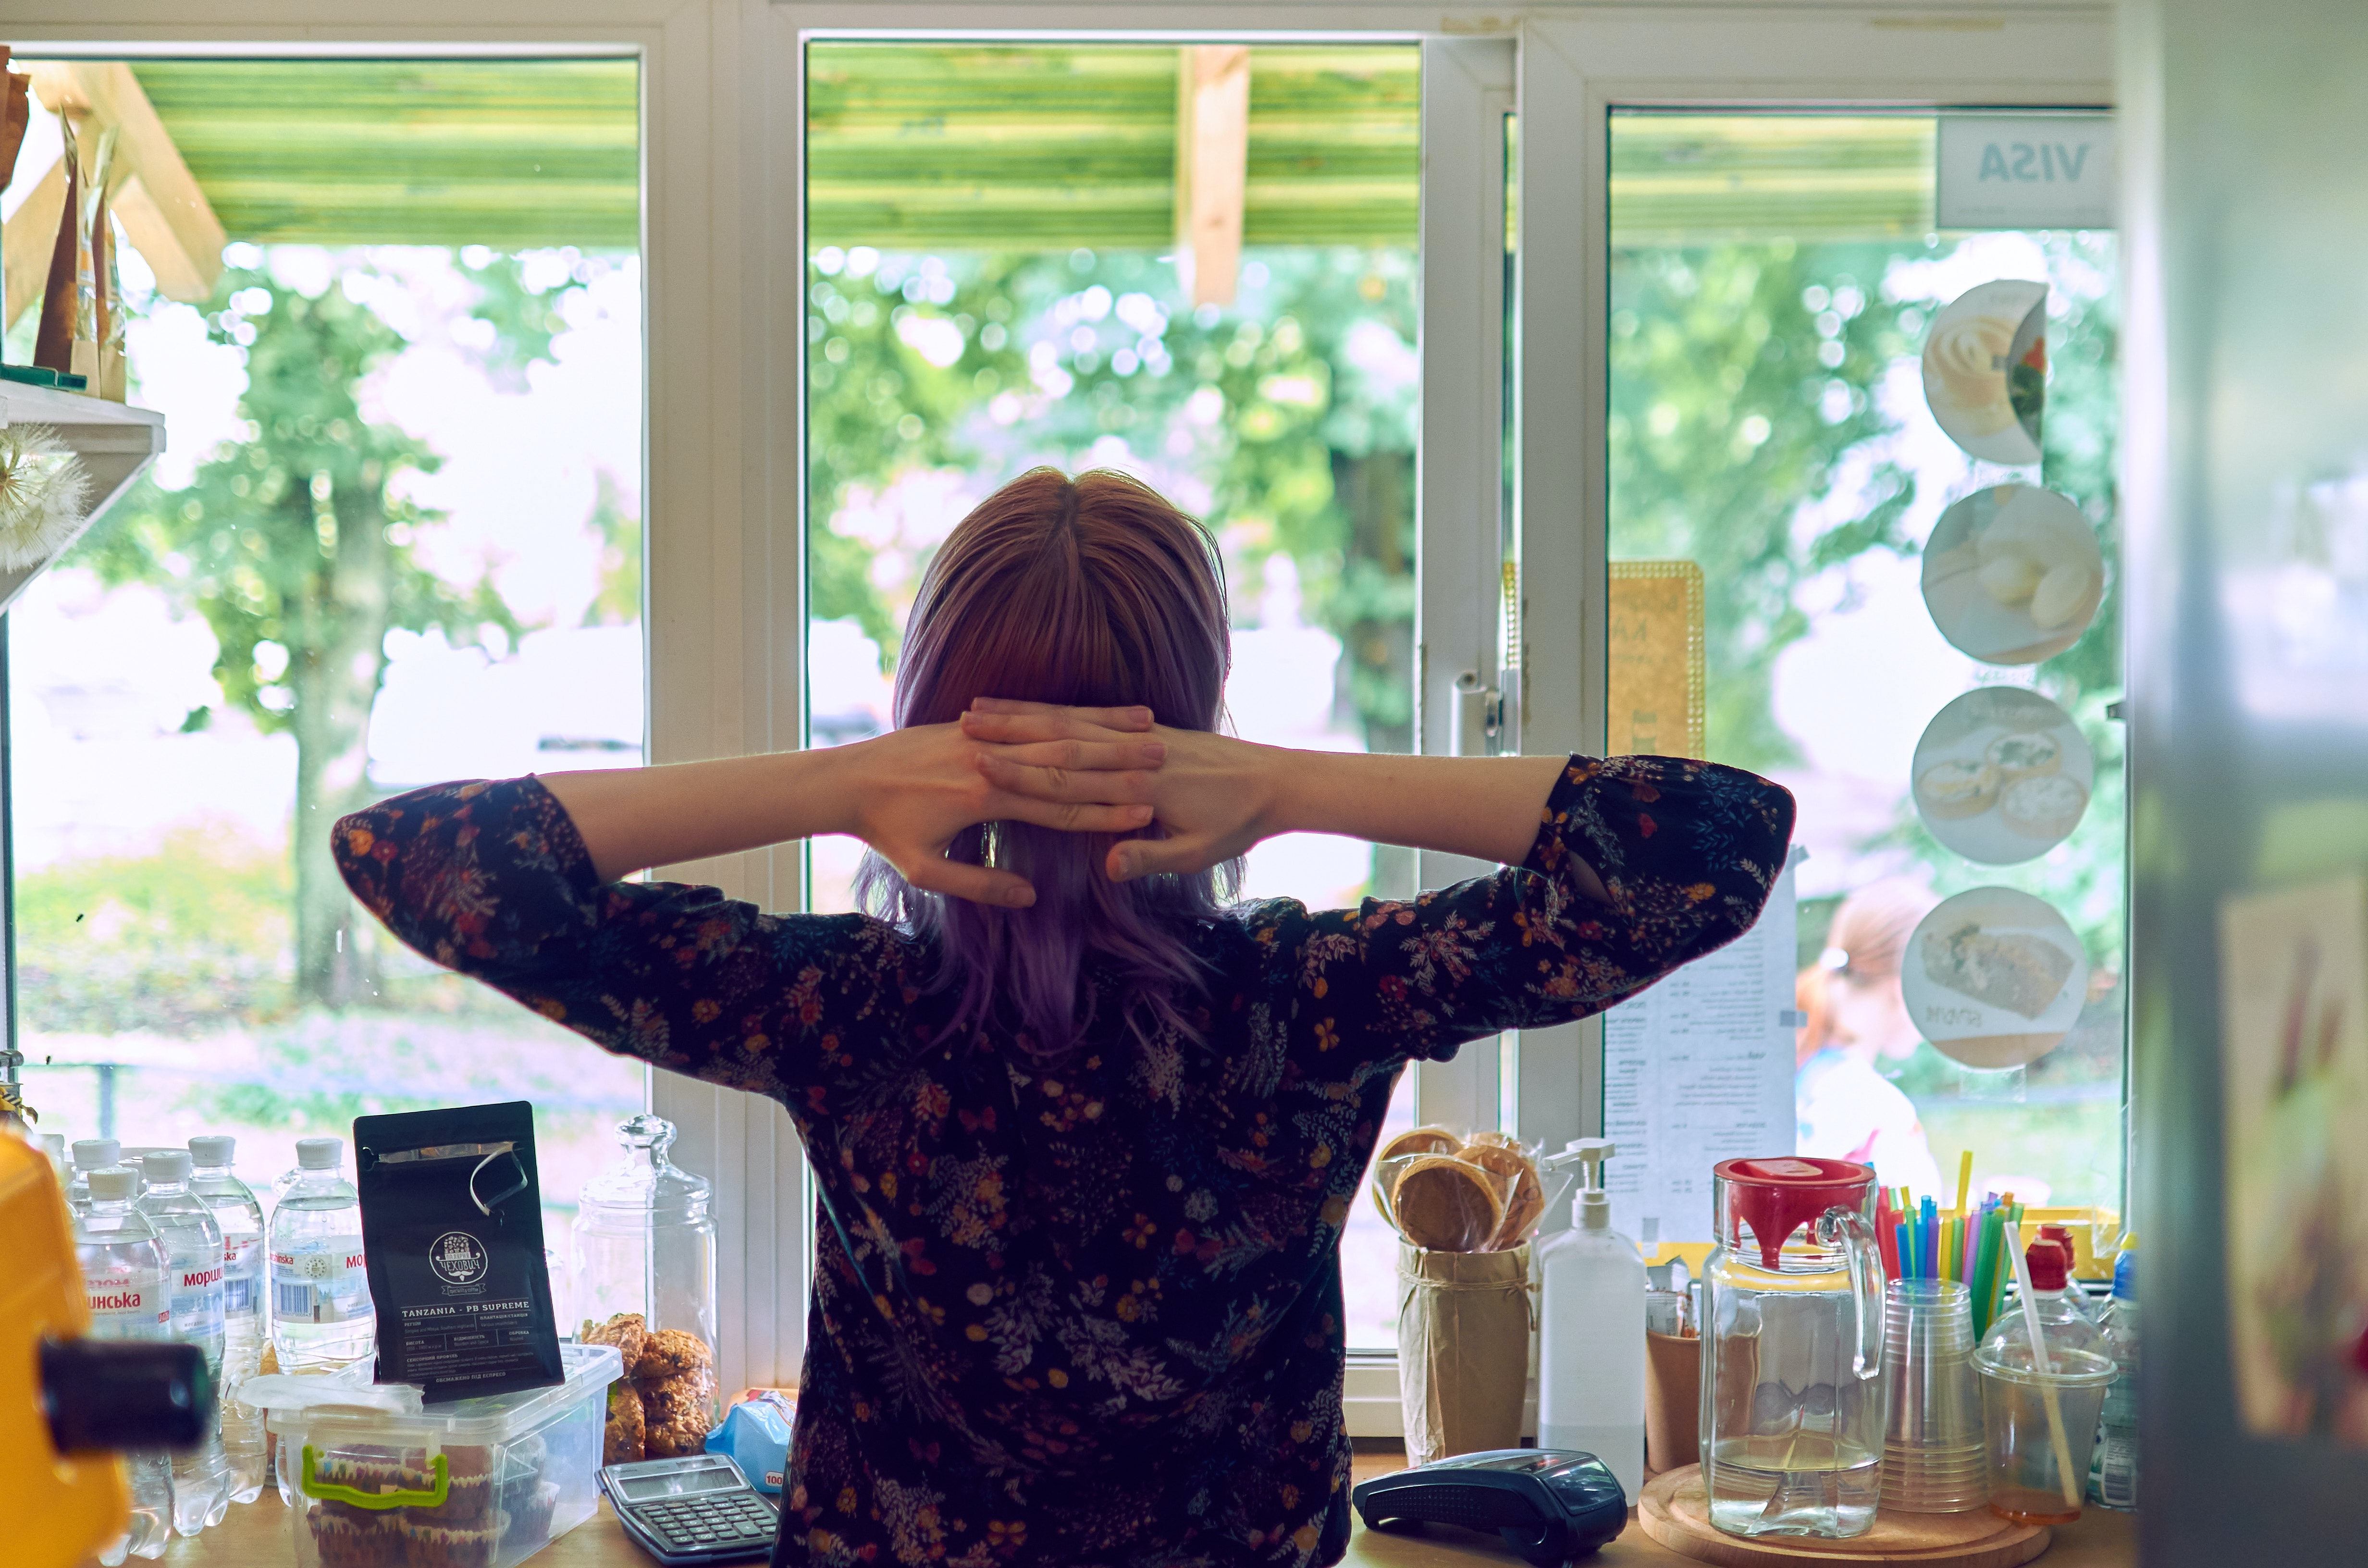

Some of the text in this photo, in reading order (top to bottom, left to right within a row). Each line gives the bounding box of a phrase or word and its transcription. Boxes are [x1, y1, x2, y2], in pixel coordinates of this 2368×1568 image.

[439, 1260, 480, 1271] ЧЕХОВИЧ
[402, 1307, 456, 1318] TANZANIA
[482, 1301, 530, 1311] SUPREME
[767, 1476, 783, 1484] 100
